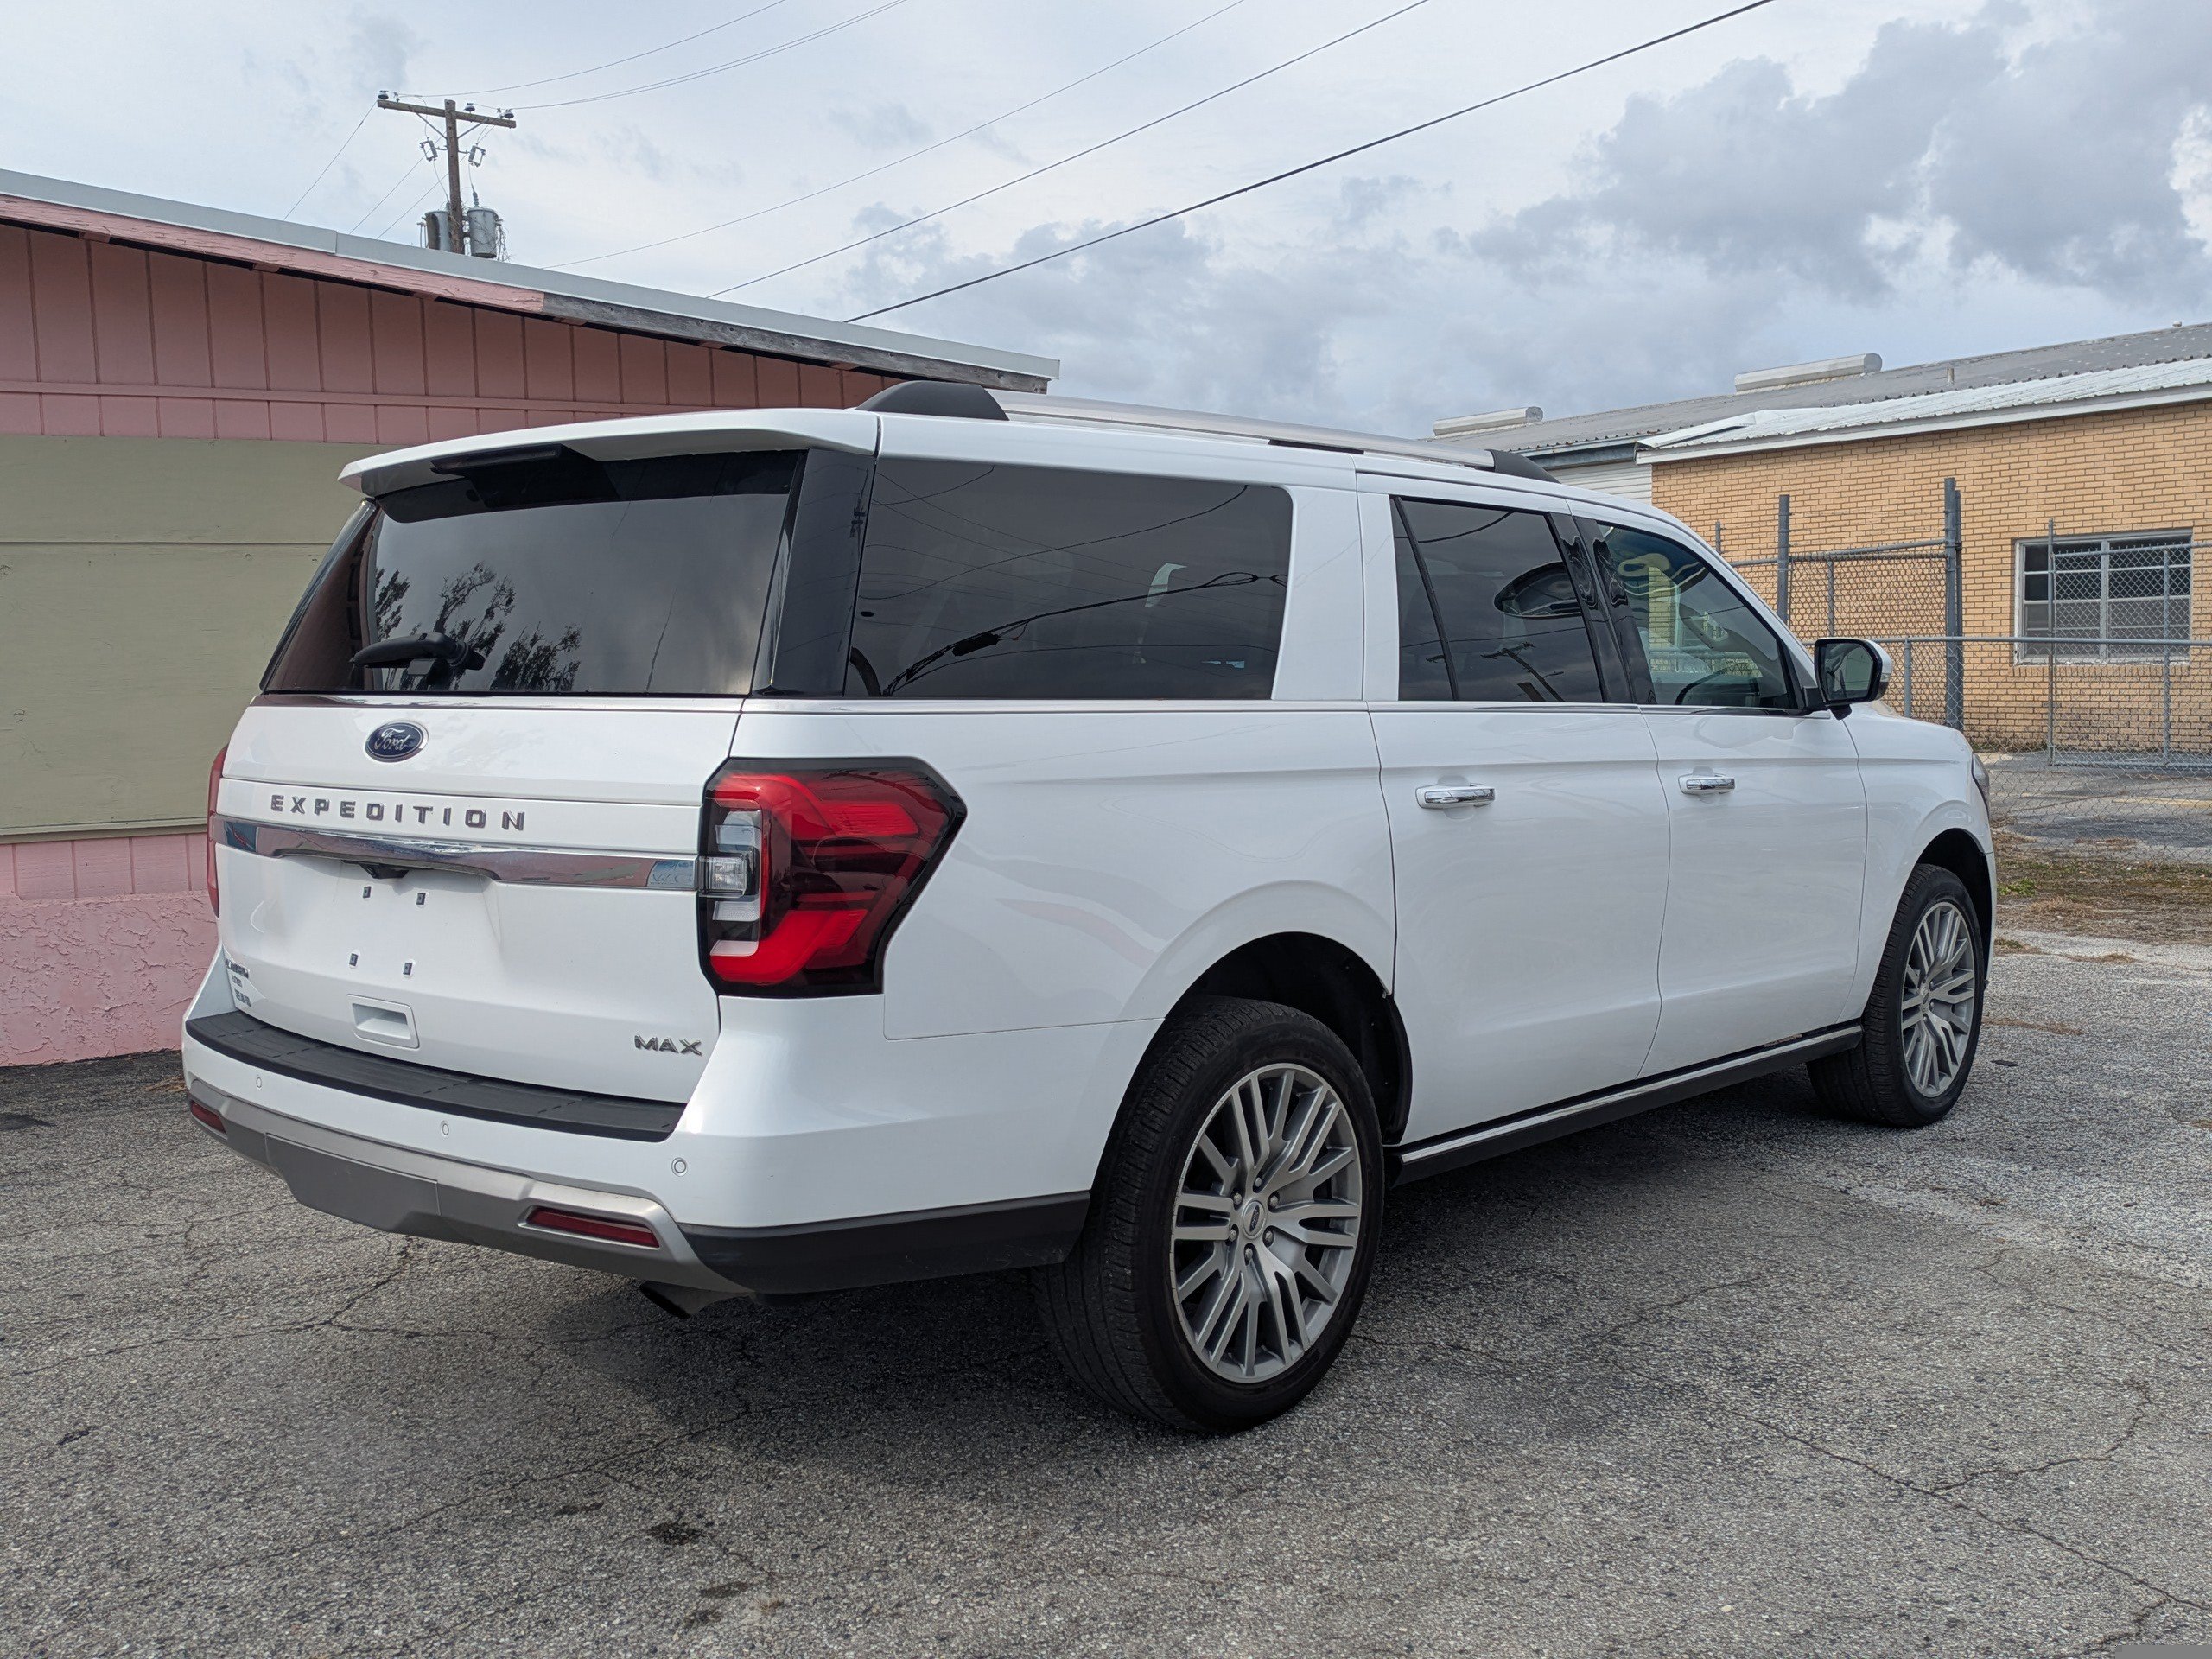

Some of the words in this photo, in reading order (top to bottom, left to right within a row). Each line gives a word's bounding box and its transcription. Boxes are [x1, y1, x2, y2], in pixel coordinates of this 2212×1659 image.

[373, 728, 411, 751] Ford
[270, 794, 524, 831] EXPEDITION
[634, 1034, 702, 1056] MAX
